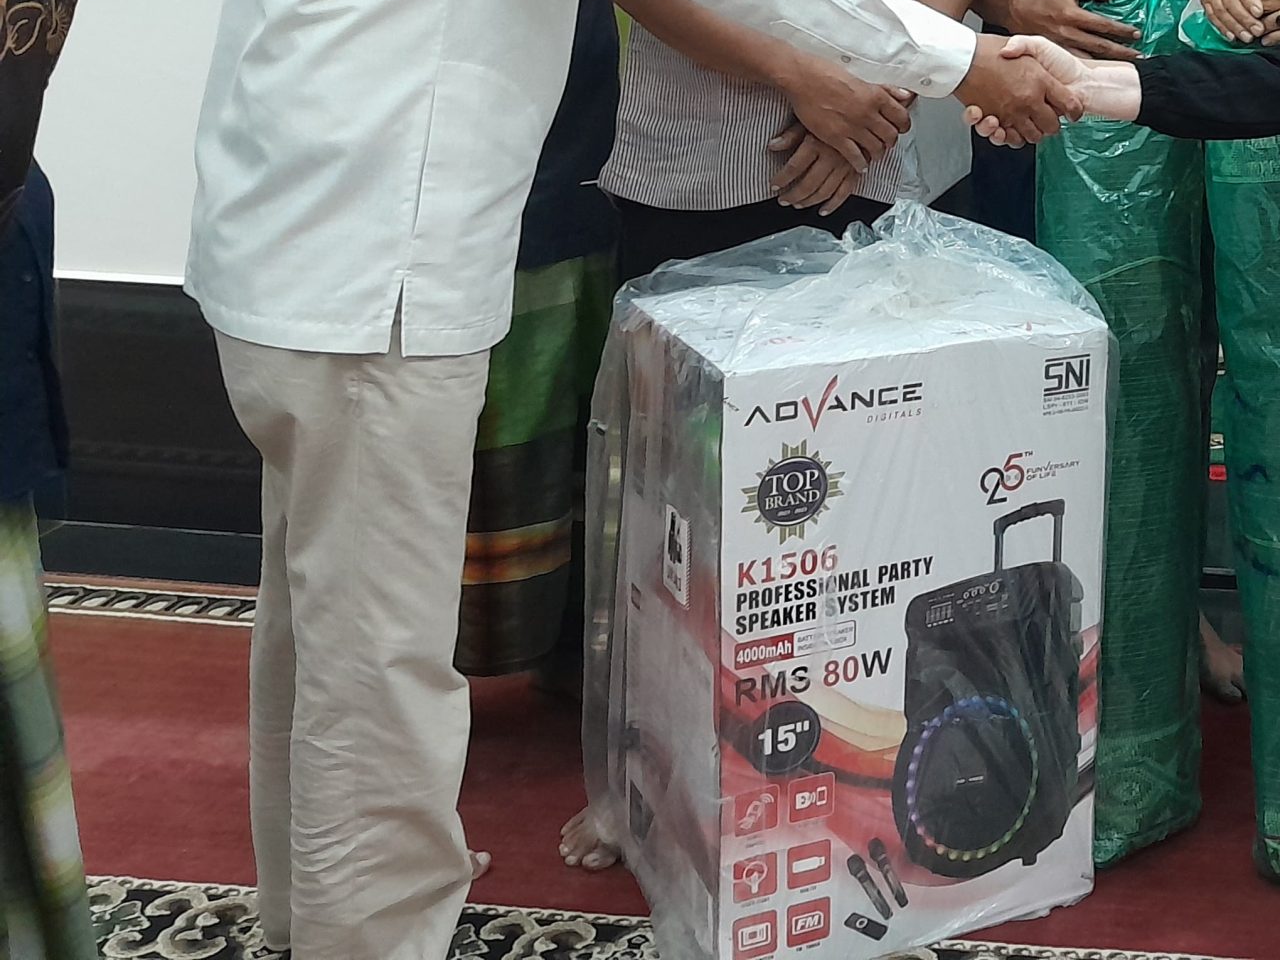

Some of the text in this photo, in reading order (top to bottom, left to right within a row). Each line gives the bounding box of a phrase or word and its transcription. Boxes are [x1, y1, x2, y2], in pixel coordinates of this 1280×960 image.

[1043, 358, 1090, 392] SNI
[744, 374, 923, 432] ADVANCE
[866, 408, 922, 424] DIGITALS
[765, 469, 819, 496] TOP
[1026, 473, 1038, 481] OF
[765, 489, 820, 510] BRAND
[737, 544, 838, 589] K1506
[736, 556, 934, 613] PROFESSIONAL PARTY
[735, 585, 896, 635] SPEAKER SYSTEM
[736, 640, 792, 664] 4000mAh
[735, 647, 893, 707] RMS 80W
[796, 914, 820, 932] FM
